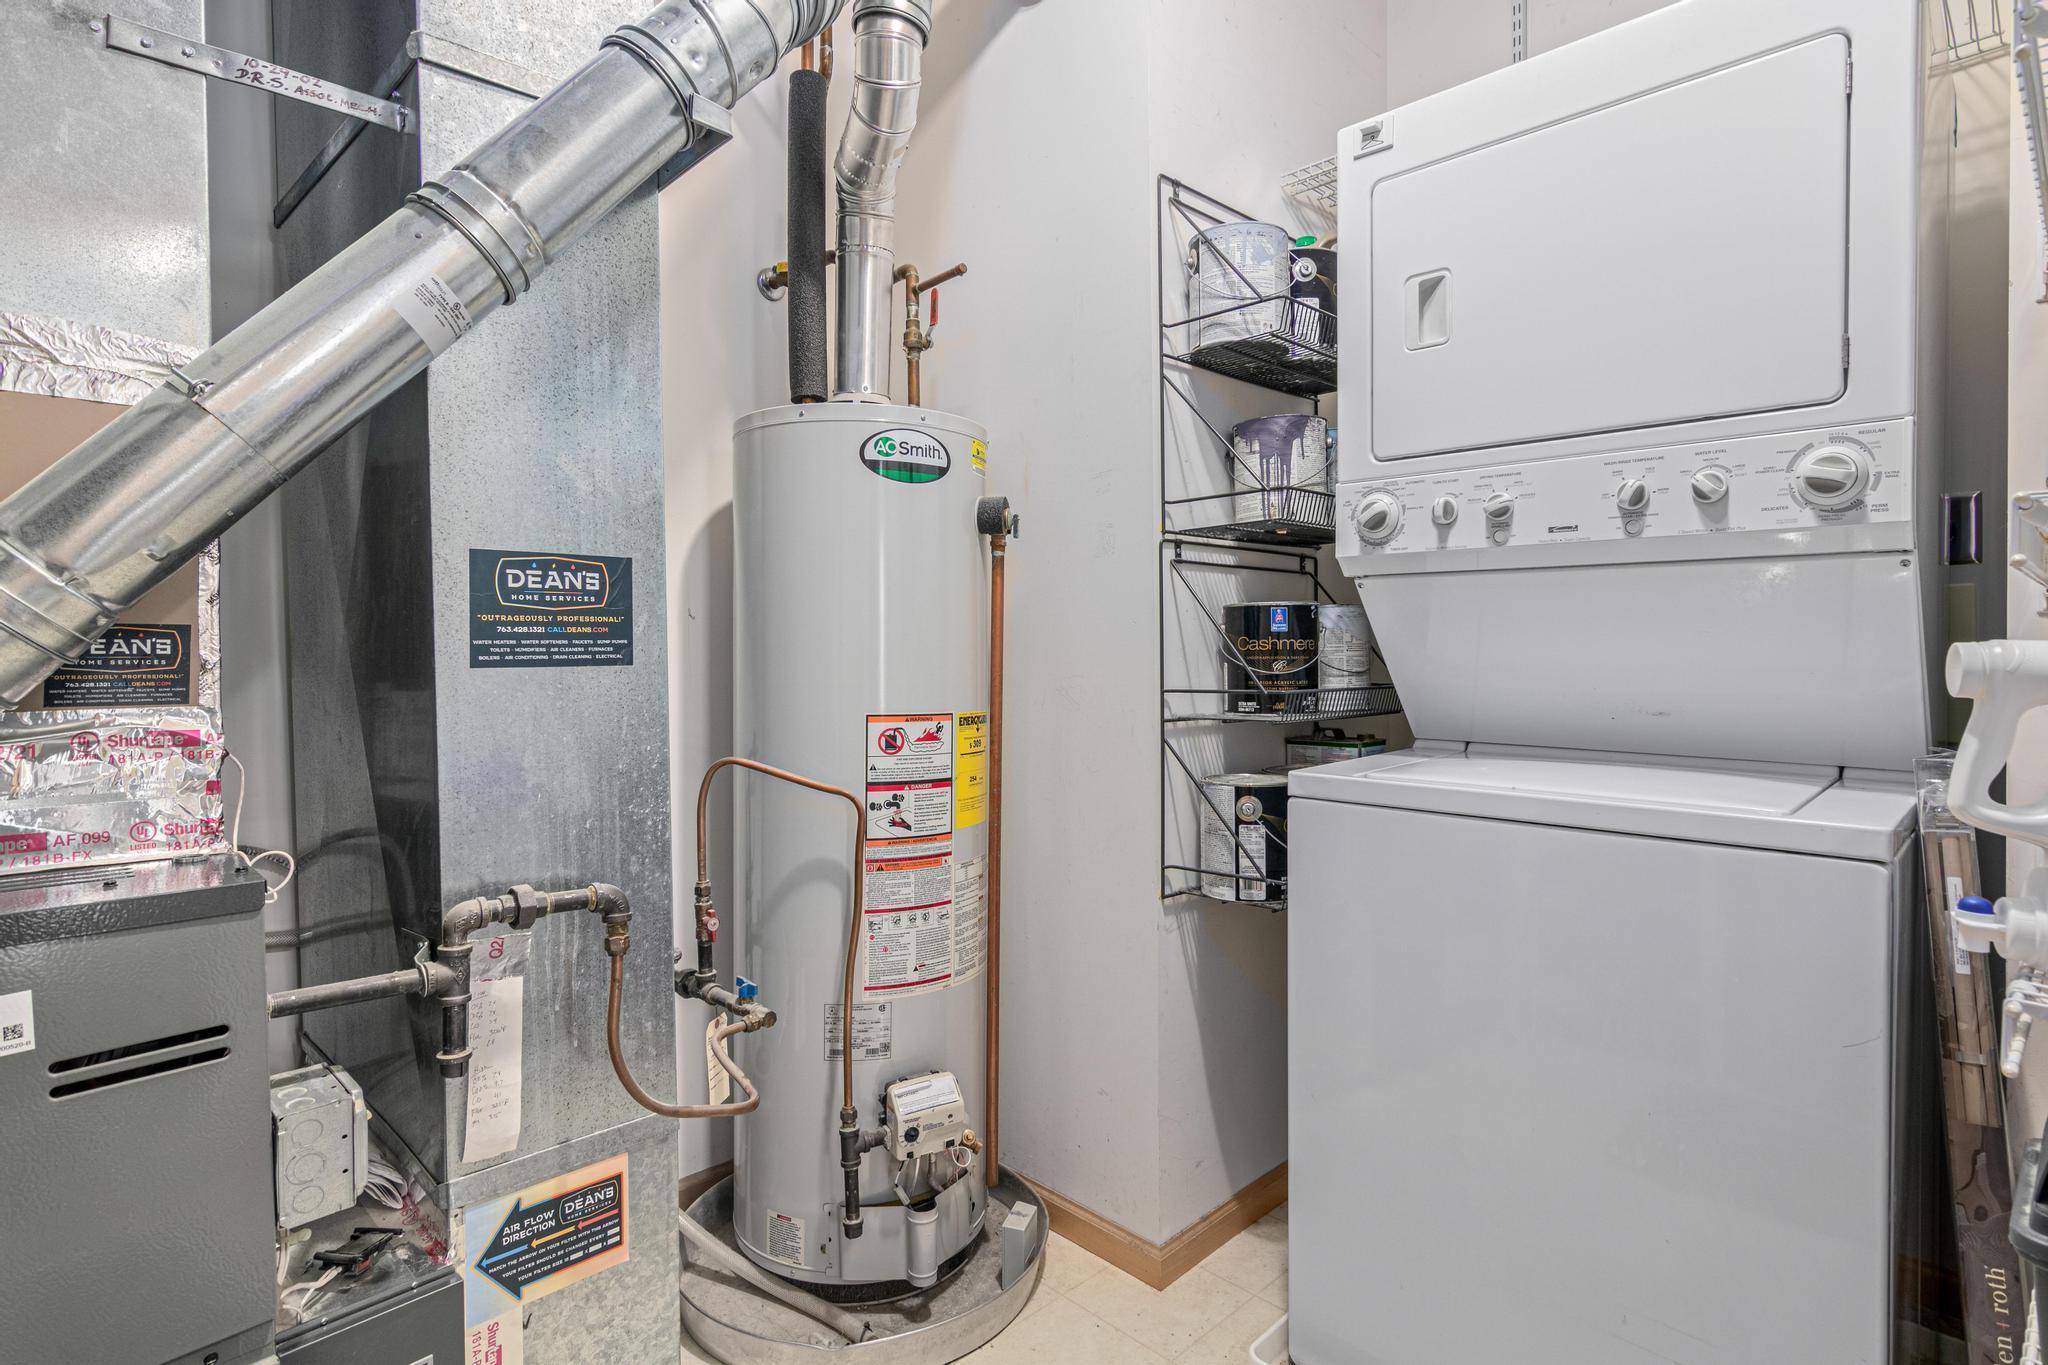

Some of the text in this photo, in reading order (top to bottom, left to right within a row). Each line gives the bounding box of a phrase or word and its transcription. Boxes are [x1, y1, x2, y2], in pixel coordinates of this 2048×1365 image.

[244, 58, 322, 88] 10-29-02
[899, 441, 940, 459] Smith
[506, 568, 600, 590] DEAN'S
[90, 638, 172, 654] EAN'S
[1238, 636, 1314, 650] Cashmere
[53, 832, 76, 847] AF
[82, 831, 110, 844] 099
[23, 850, 92, 866] 181B-FX
[564, 1186, 614, 1214] DEAN'S
[502, 1209, 555, 1236] AIR FLOW
[502, 1219, 556, 1246] DIRECTION
[488, 1263, 506, 1274] MATCH
[518, 1252, 538, 1262] ARROW
[1984, 1268, 2010, 1315] roth
[1994, 1336, 2014, 1365] en
